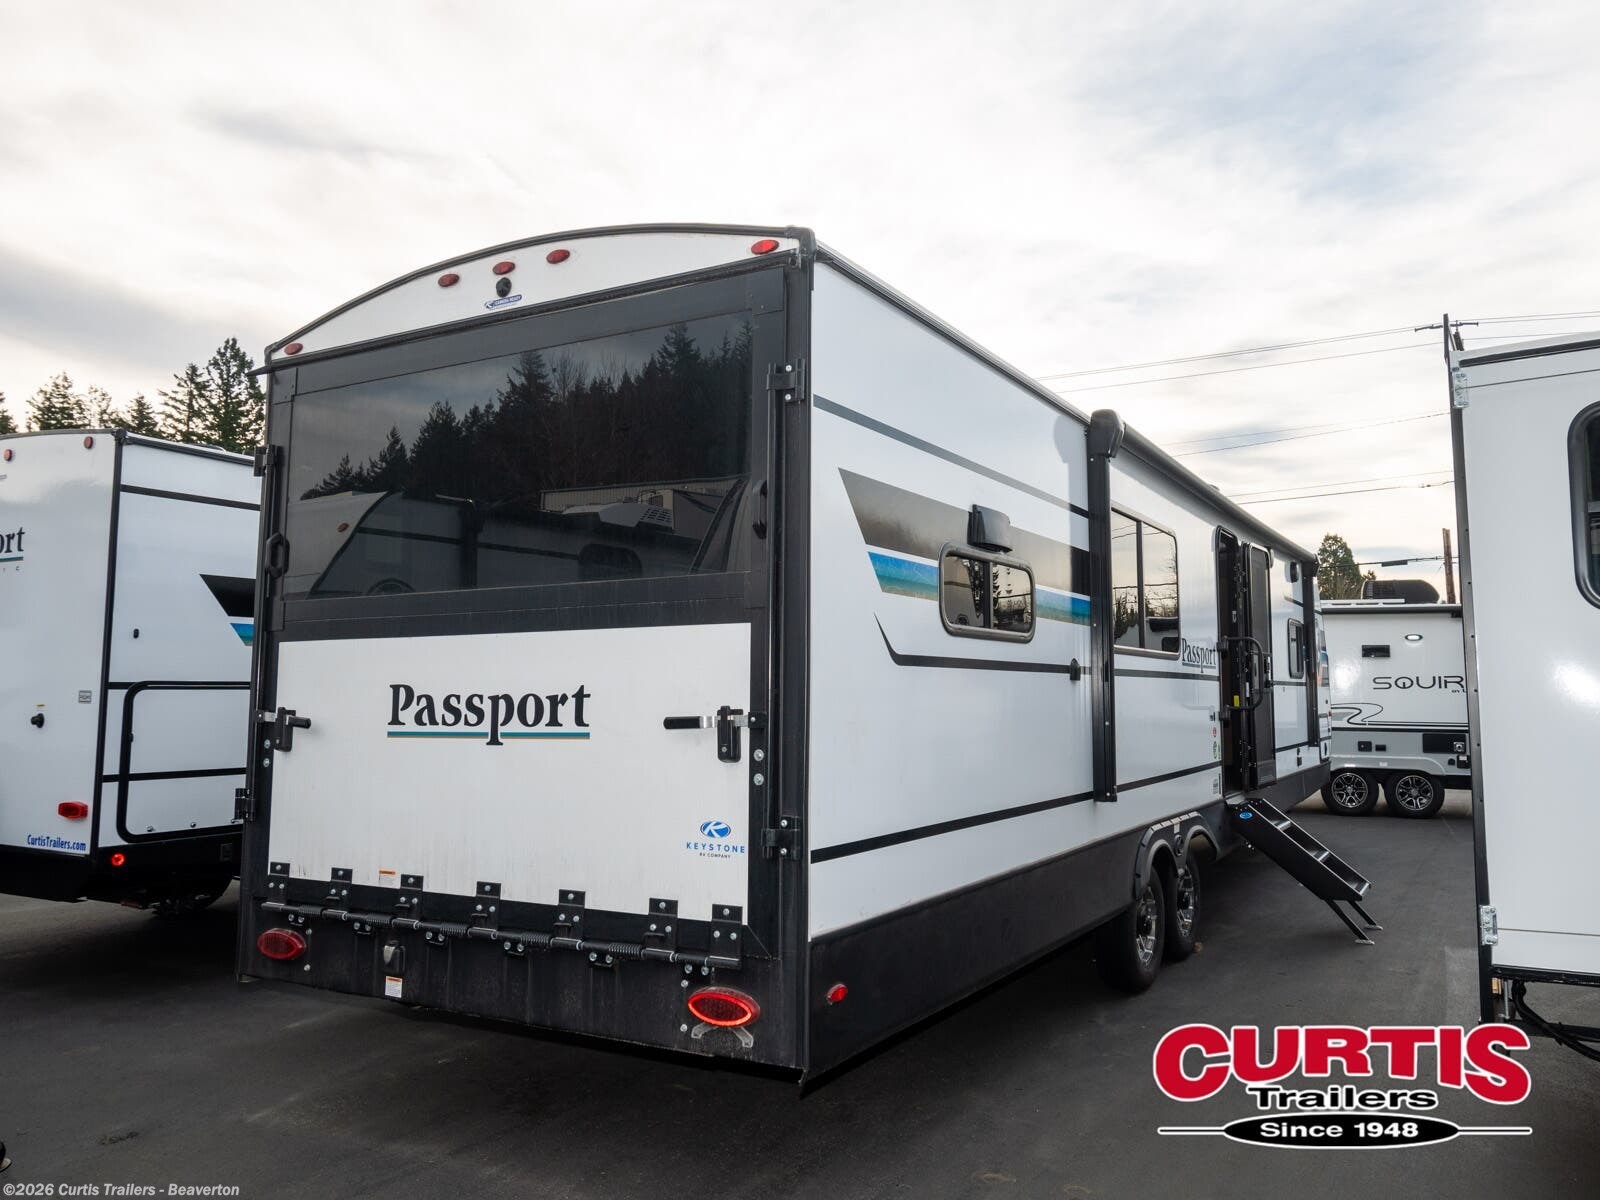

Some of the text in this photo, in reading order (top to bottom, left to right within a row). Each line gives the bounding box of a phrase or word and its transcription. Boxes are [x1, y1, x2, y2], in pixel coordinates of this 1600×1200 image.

[1182, 638, 1216, 673] Passport
[387, 684, 591, 746] Passport
[27, 834, 87, 851] CurtisTrailers.com
[686, 841, 745, 853] KEYSTONE
